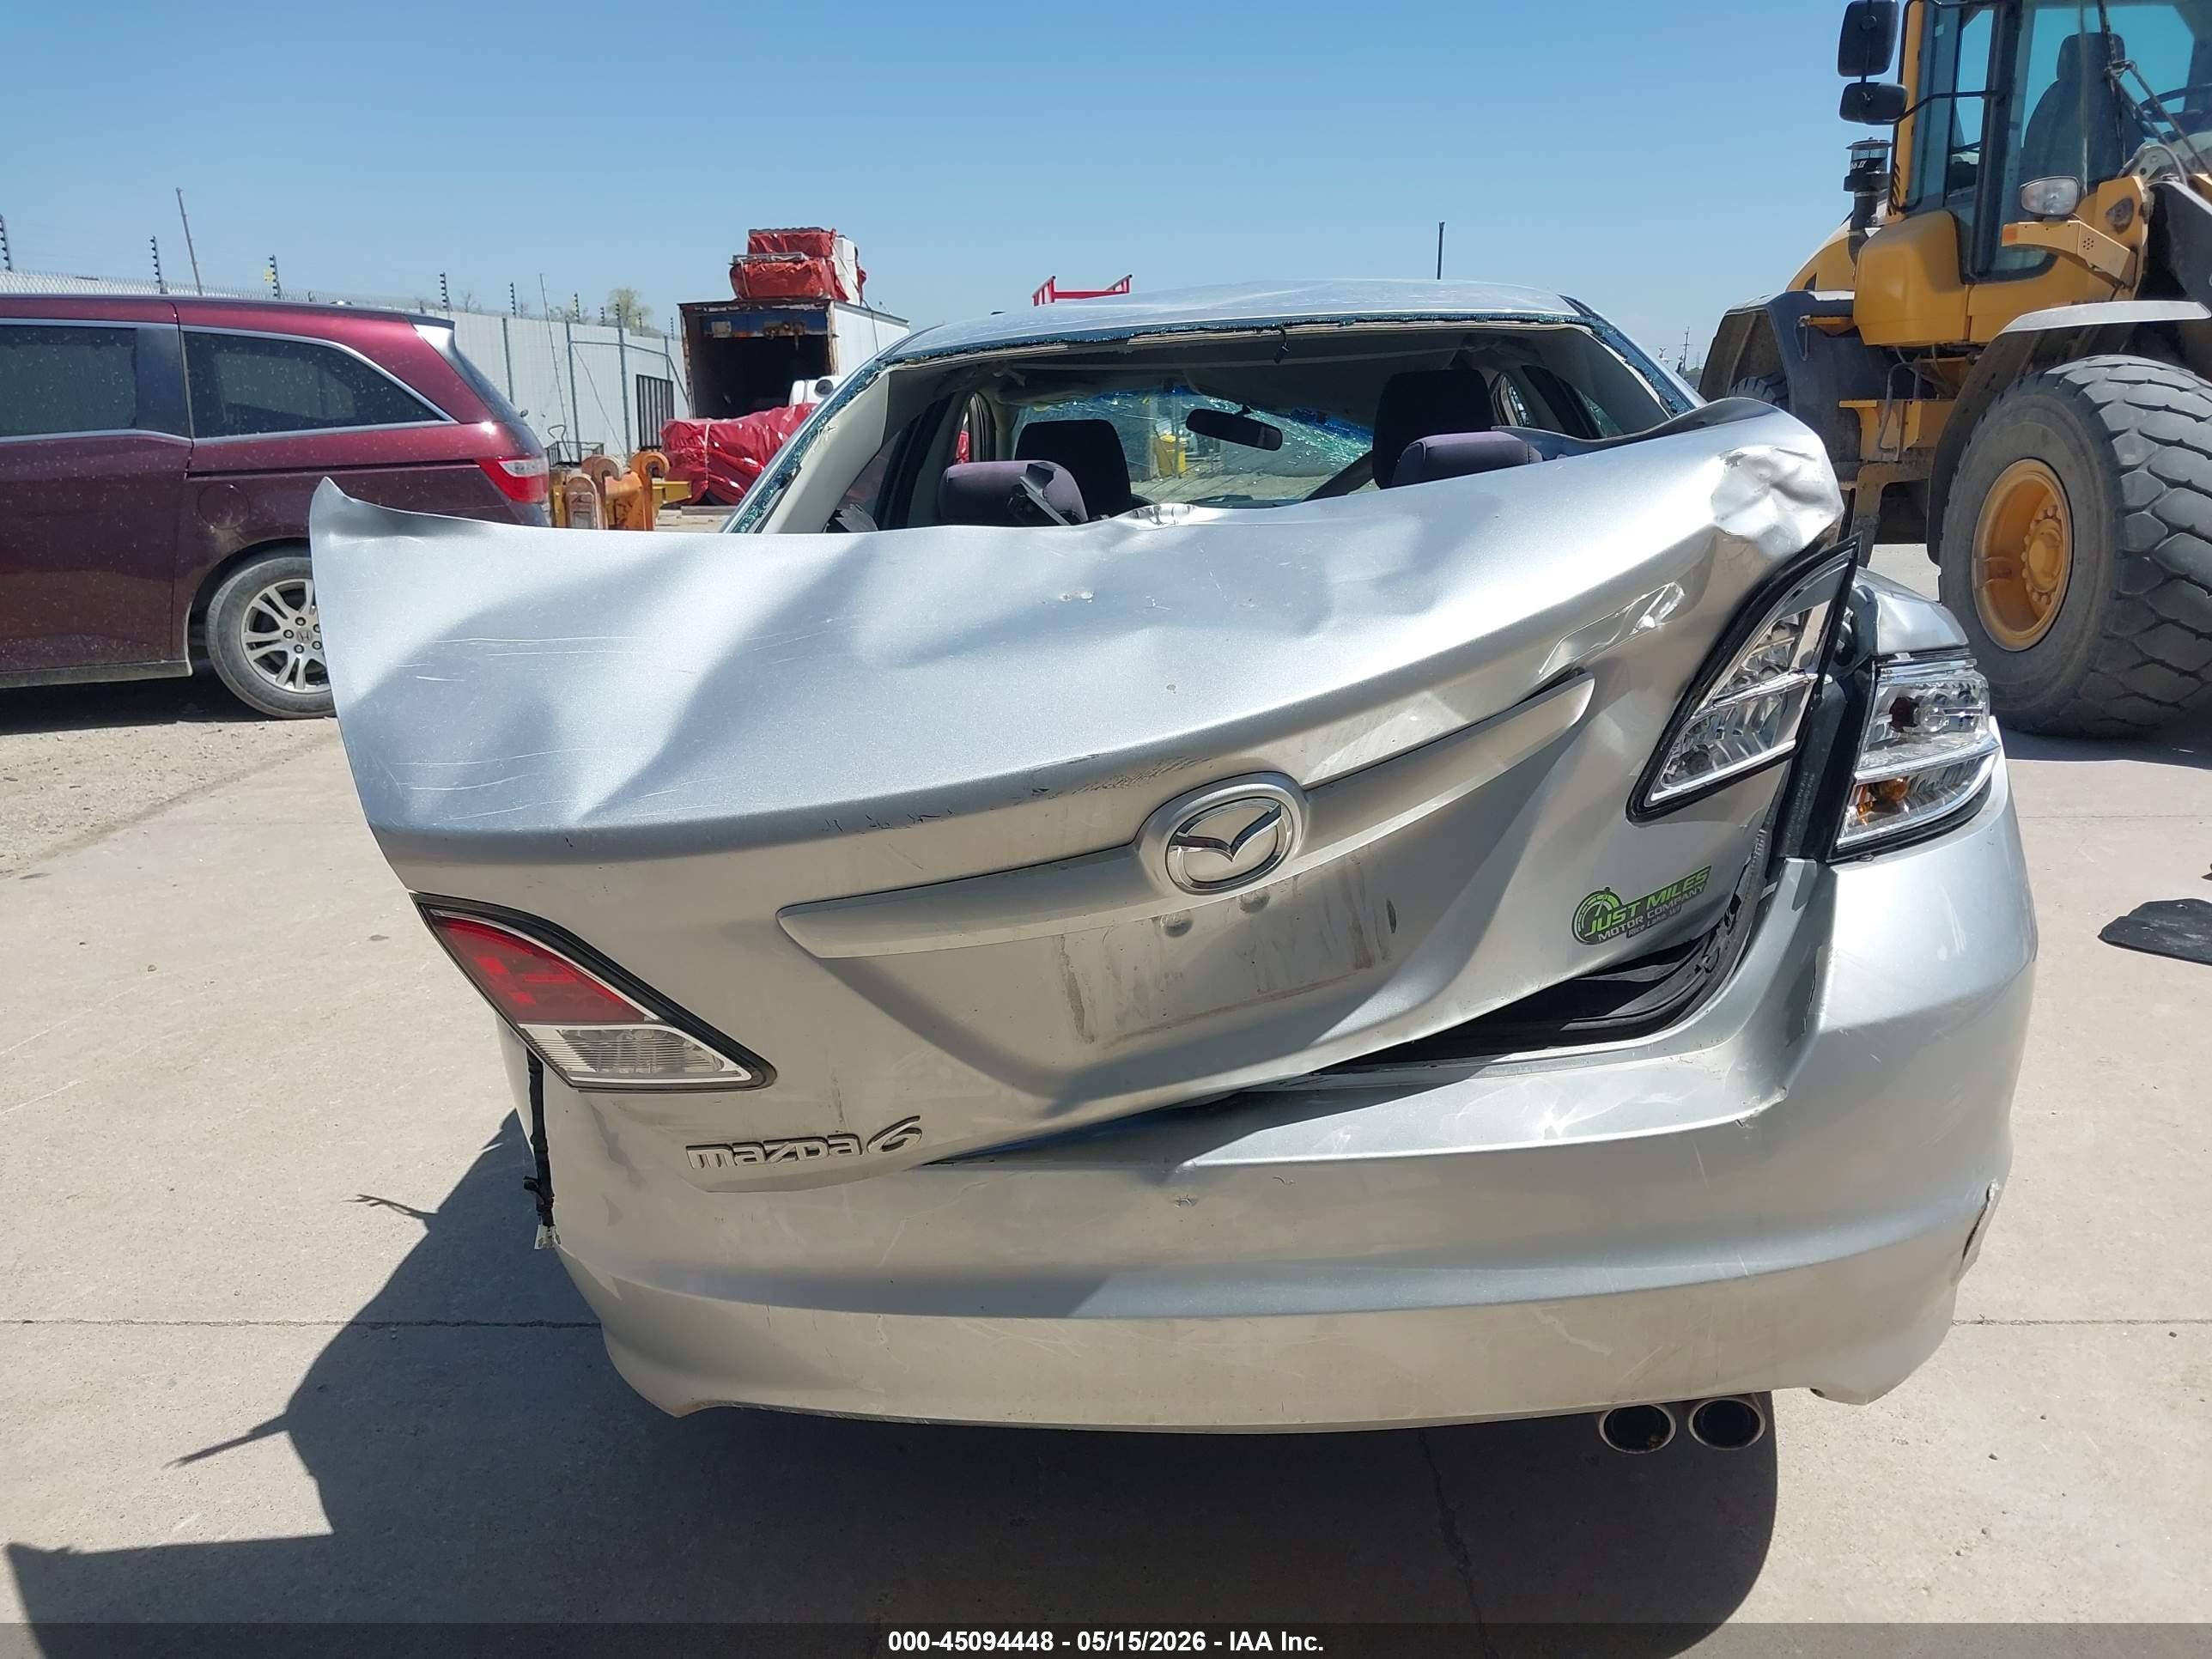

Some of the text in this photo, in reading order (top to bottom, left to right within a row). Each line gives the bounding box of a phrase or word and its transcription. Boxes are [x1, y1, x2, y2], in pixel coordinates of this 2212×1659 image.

[1585, 867, 1711, 937] JUST MILES
[1598, 885, 1704, 942] MOTOR COMPANY
